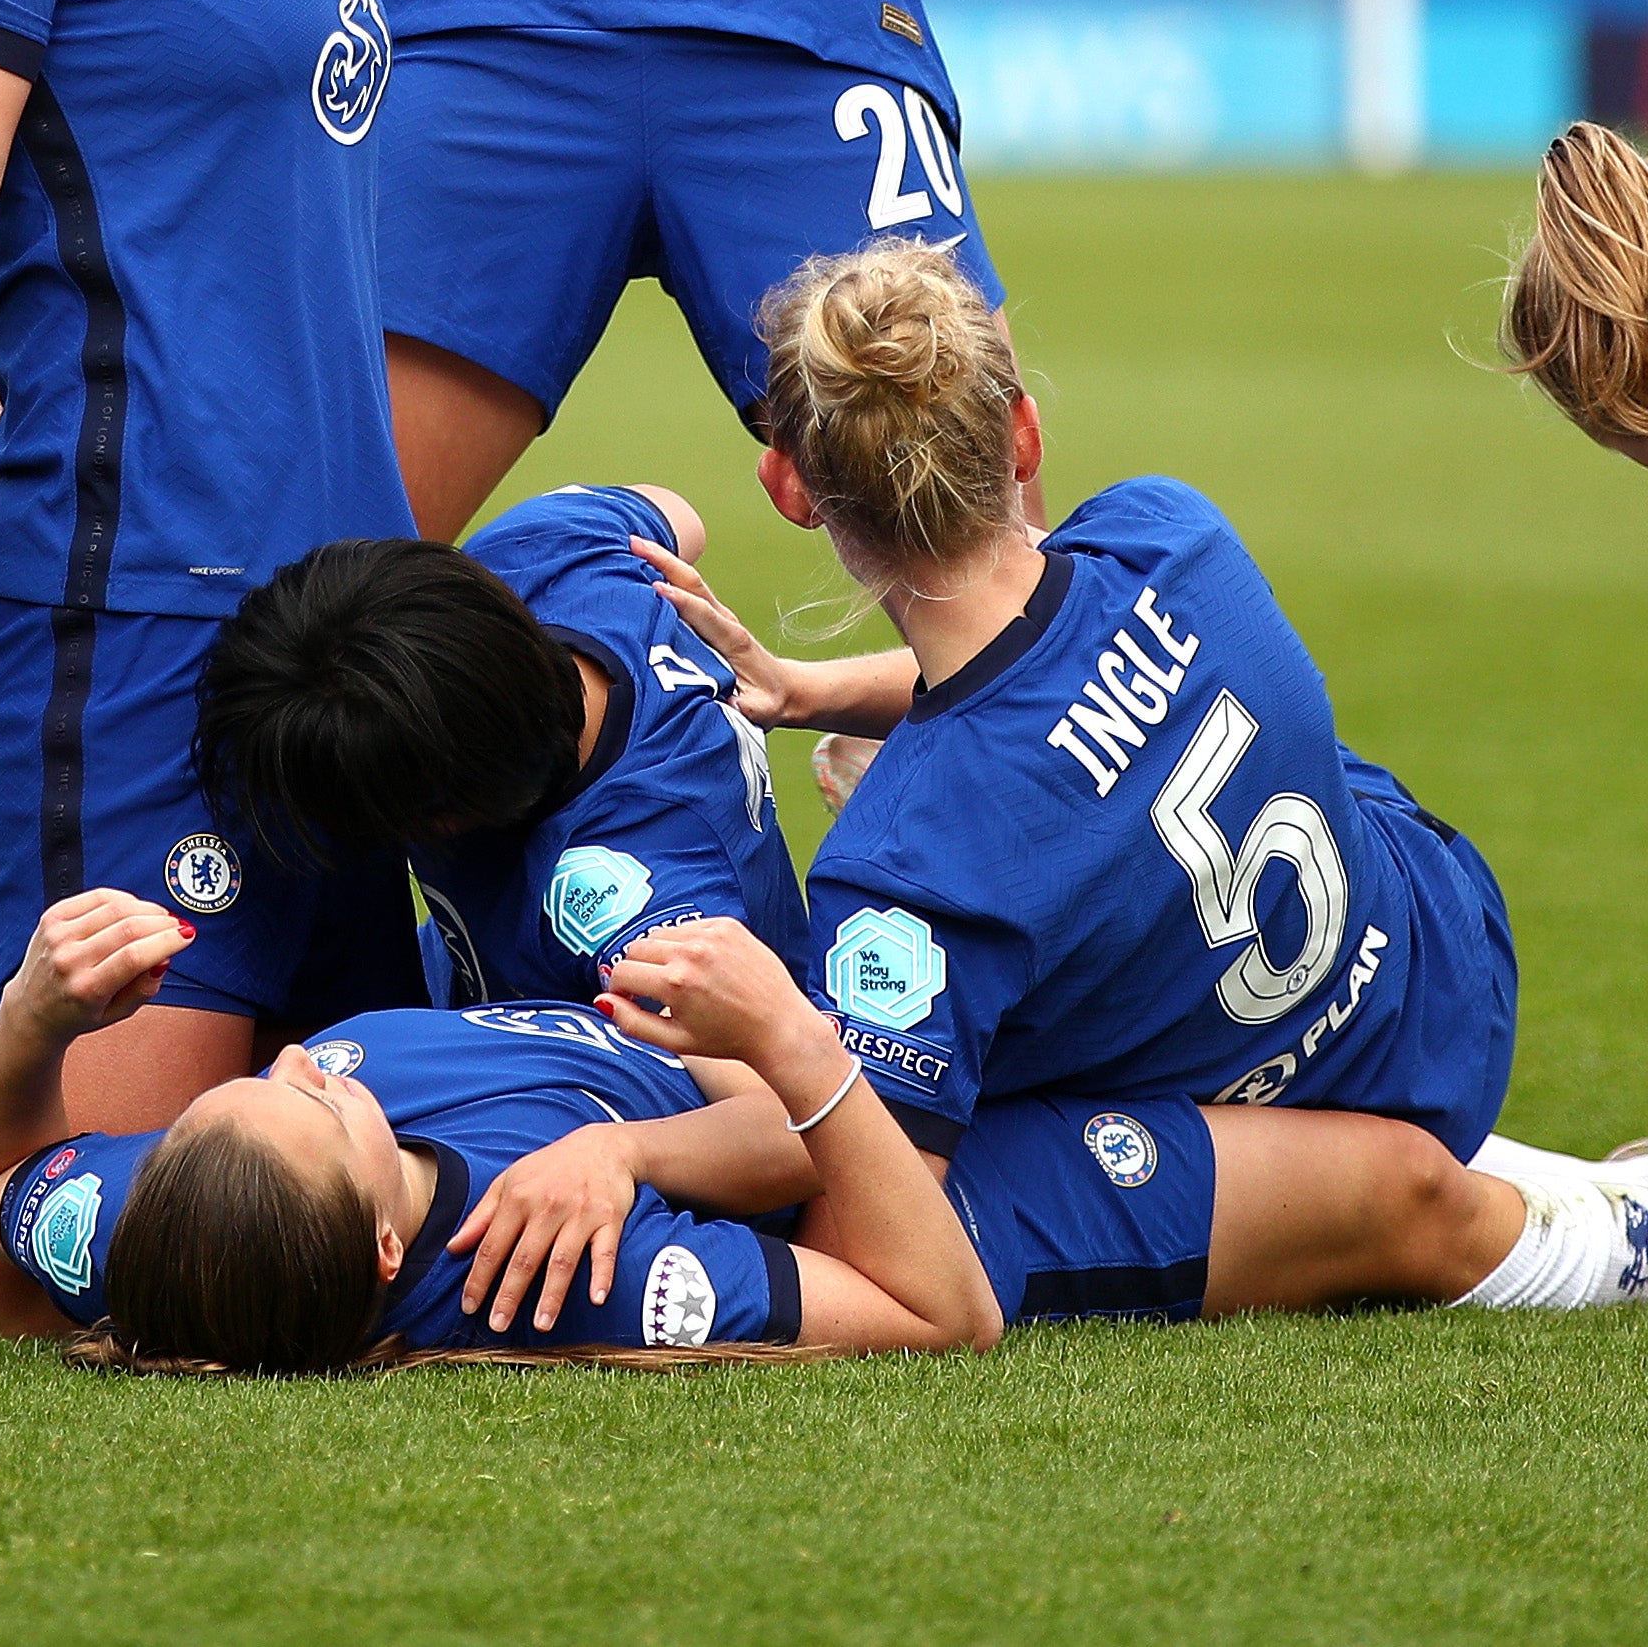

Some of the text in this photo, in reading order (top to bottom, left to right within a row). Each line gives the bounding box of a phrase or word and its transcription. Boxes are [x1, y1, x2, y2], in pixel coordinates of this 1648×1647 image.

[833, 83, 964, 231] 20
[1047, 586, 1200, 798] INGLE
[179, 837, 227, 856] CHELSEA
[1149, 688, 1349, 1026] 5
[573, 887, 598, 915] Play
[859, 950, 880, 962] We
[859, 964, 889, 979] Play
[859, 978, 906, 993] Strong
[1302, 924, 1390, 1059] PLAN
[842, 1028, 949, 1081] RESPECT
